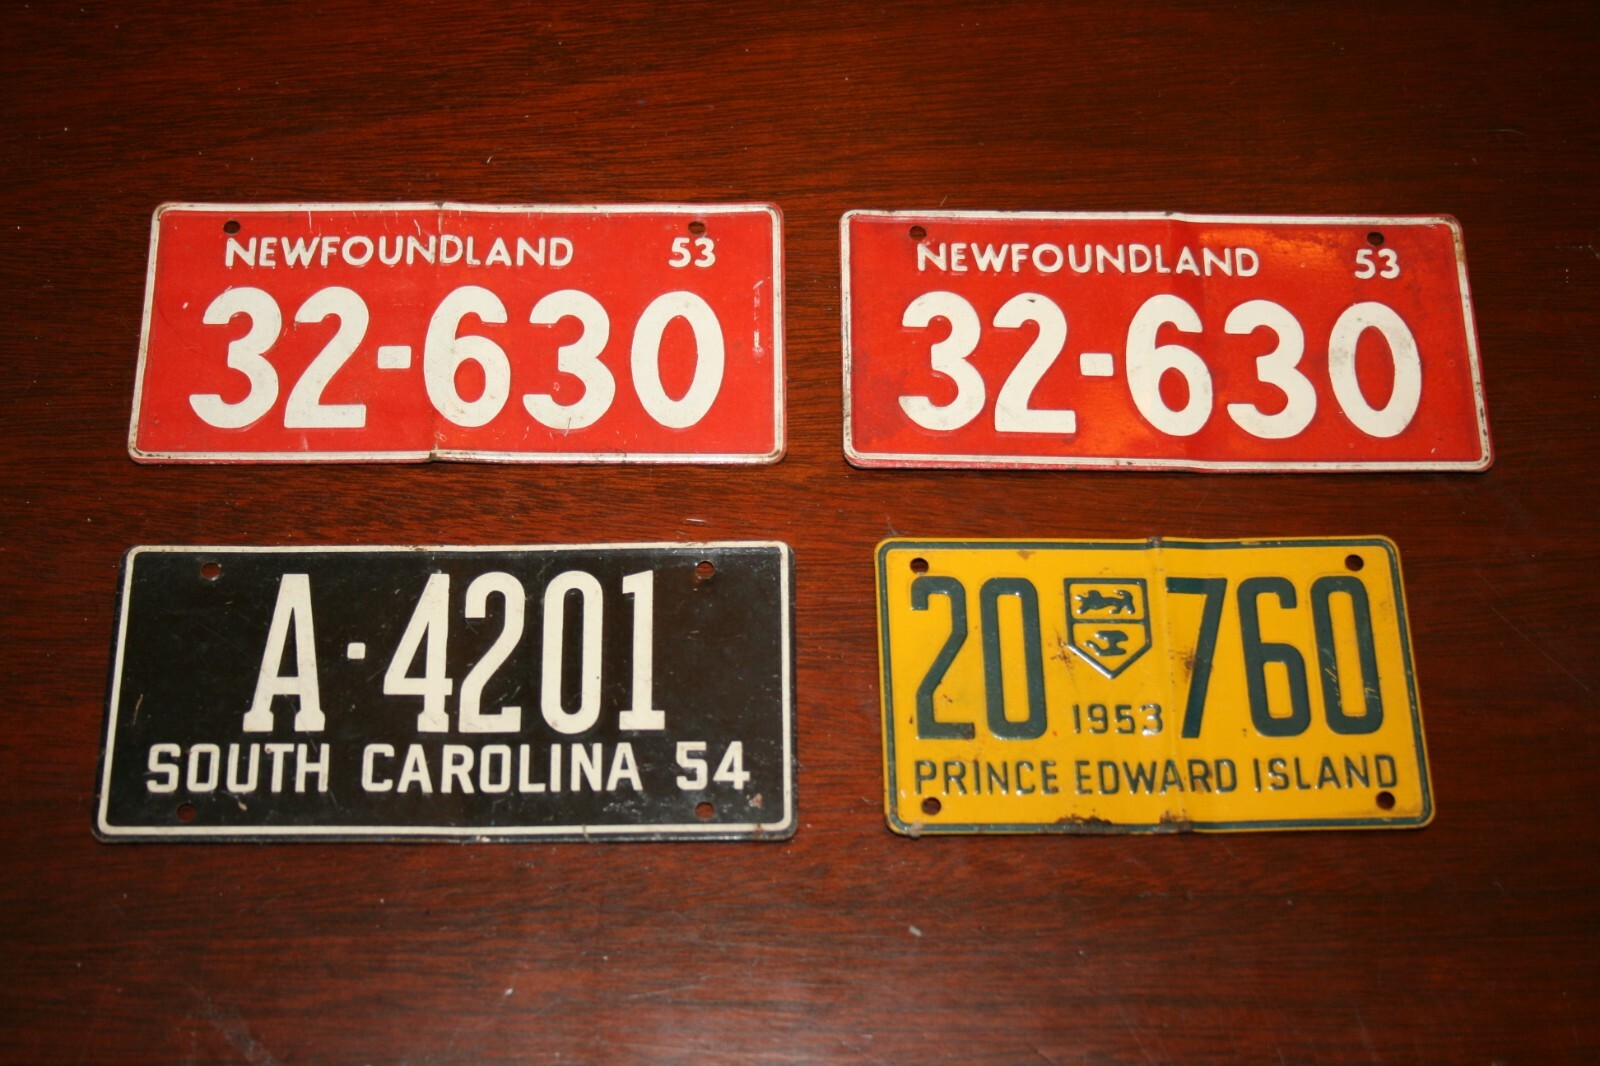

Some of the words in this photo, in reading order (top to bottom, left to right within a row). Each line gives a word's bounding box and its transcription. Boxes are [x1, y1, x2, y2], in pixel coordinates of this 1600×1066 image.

[224, 233, 575, 271] NEWFOUNDLAND
[667, 235, 717, 270] 53
[914, 241, 1260, 279] NEWFOUNDLAND
[1353, 247, 1401, 281] 53
[188, 284, 726, 431] 32-630
[897, 289, 1423, 440] 32-630
[910, 575, 1049, 740] 20
[1165, 574, 1385, 739] 760
[1072, 702, 1164, 735] 1953
[146, 742, 331, 794] SOUTH
[361, 742, 644, 794] CAROLINA
[675, 740, 752, 792] 54
[914, 759, 1060, 796] PRINCE
[1075, 758, 1239, 796] EDWARD
[1252, 753, 1397, 793] ISLAND
